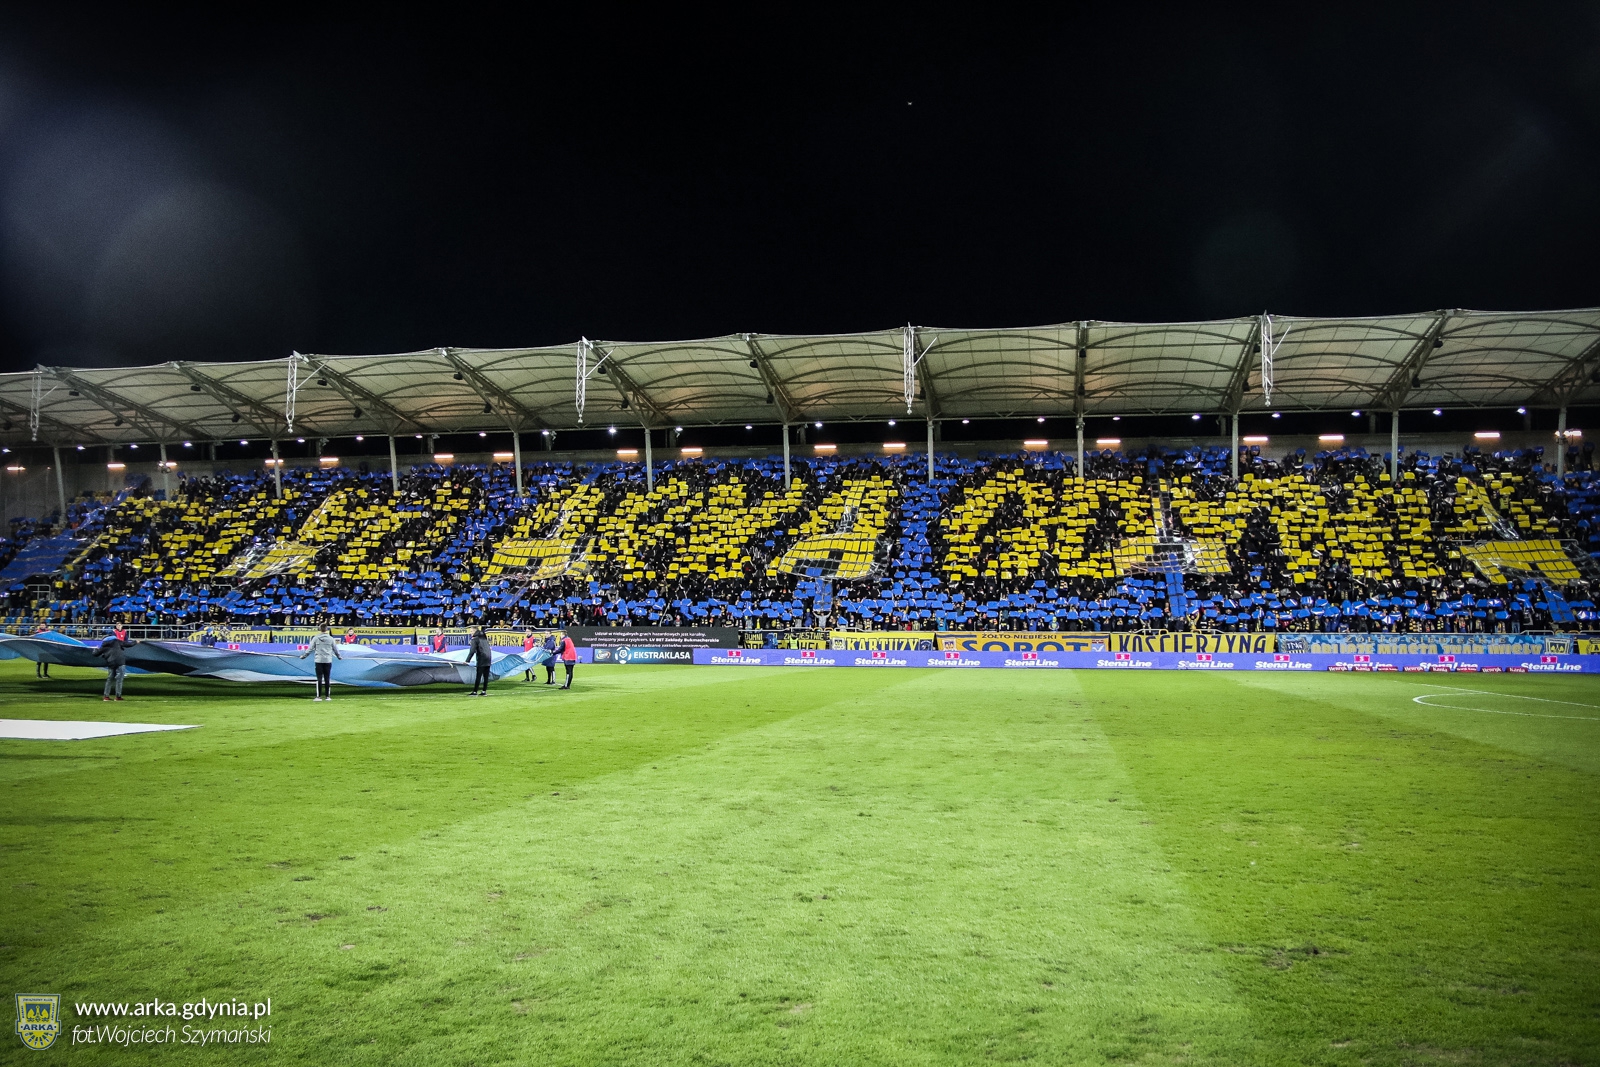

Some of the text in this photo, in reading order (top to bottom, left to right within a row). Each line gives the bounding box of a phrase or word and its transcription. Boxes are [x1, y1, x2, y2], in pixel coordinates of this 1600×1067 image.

[846, 637, 919, 651] KARTUZY
[633, 651, 691, 660] EKSTRAKLASA
[710, 656, 762, 664] Stena Line
[814, 657, 836, 665] Line
[854, 657, 907, 666] Stena Line
[927, 658, 981, 667] Stena Line
[1004, 659, 1059, 667] Stena Line
[1097, 659, 1128, 667] Stena
[1178, 660, 1235, 668] Stena Line
[1287, 661, 1312, 669] Line
[1521, 662, 1582, 671] Stena Line
